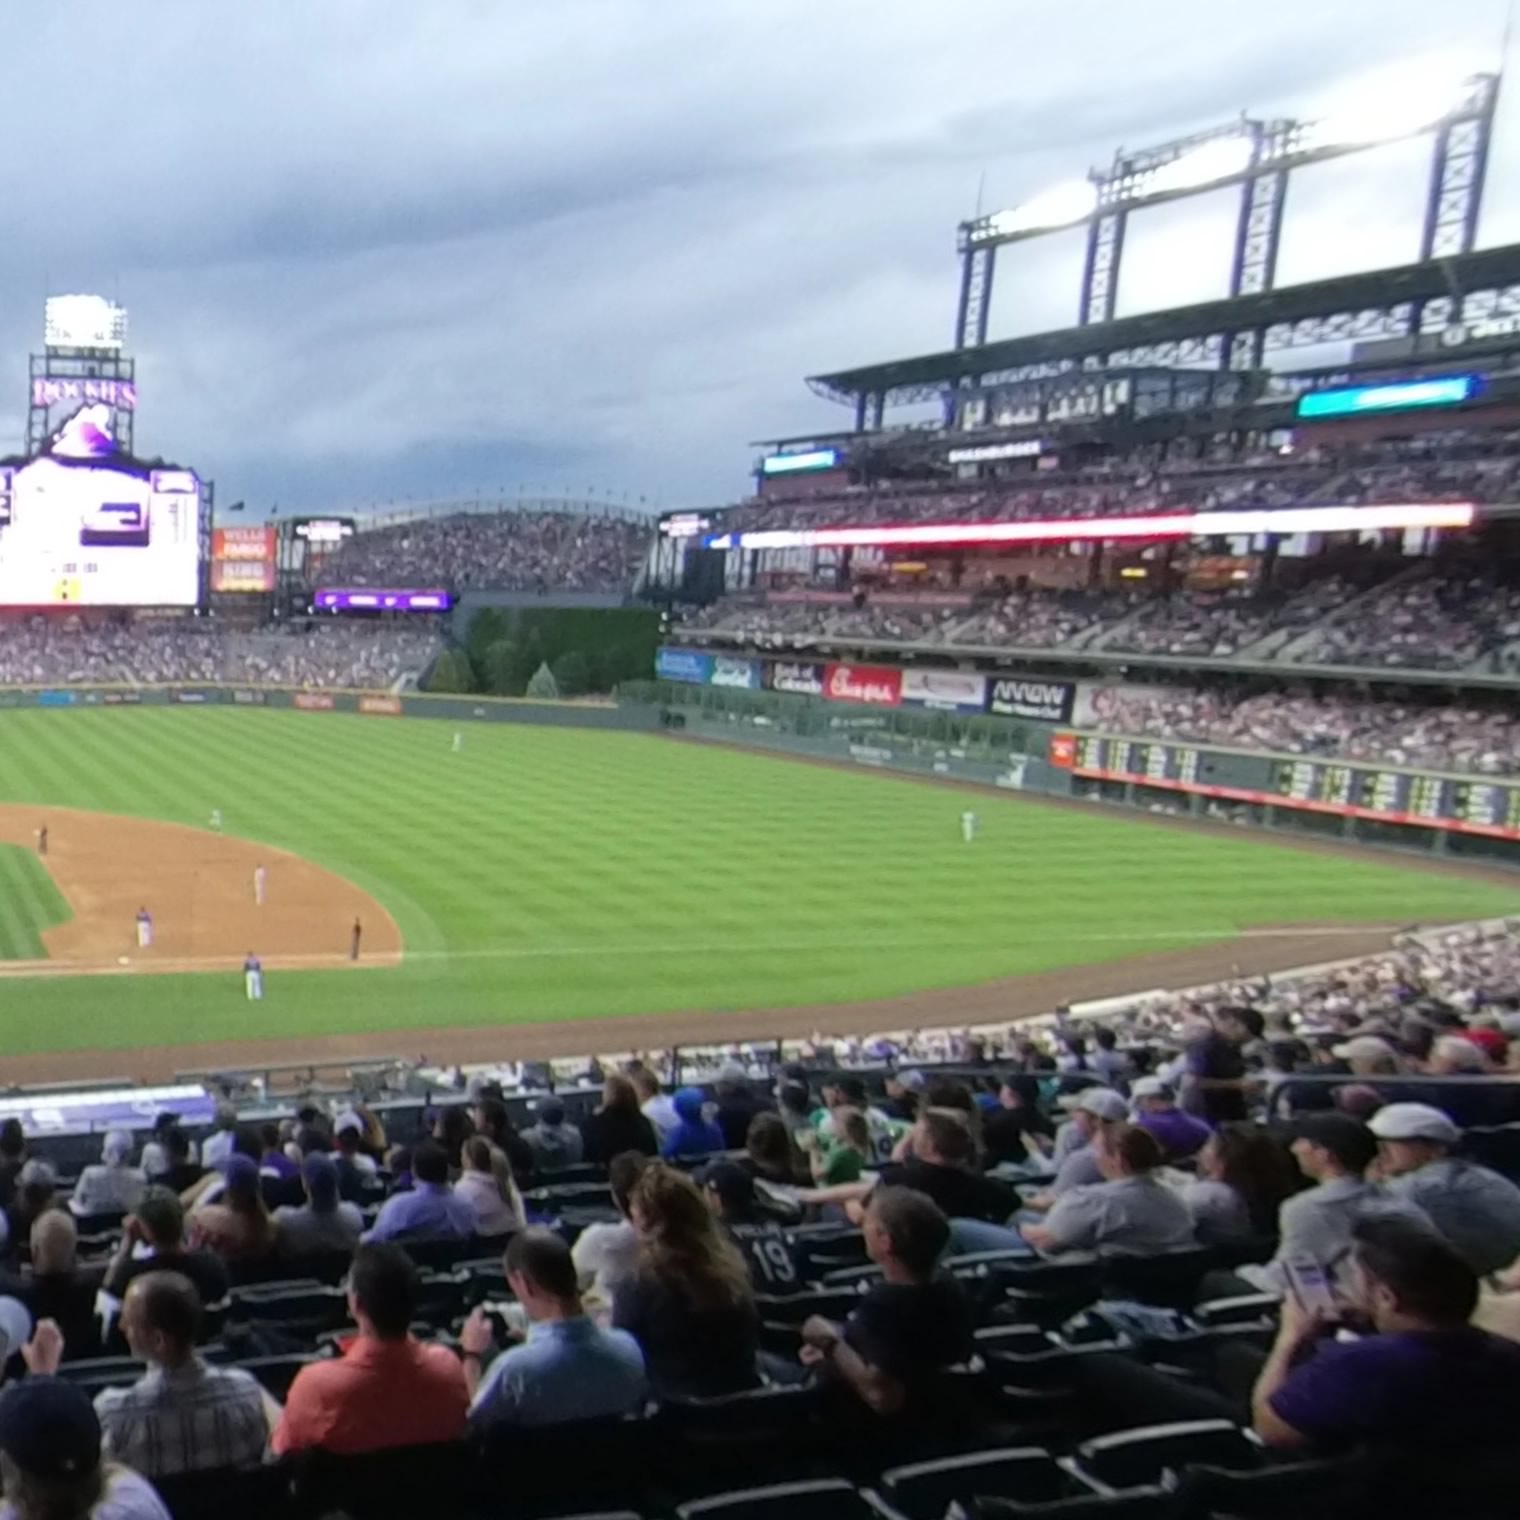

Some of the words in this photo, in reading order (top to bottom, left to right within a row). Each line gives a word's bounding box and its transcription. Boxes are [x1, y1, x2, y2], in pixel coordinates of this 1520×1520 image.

[33, 377, 138, 407] ROCKIES
[992, 680, 1066, 705] ARROW
[752, 1239, 796, 1282] 19
